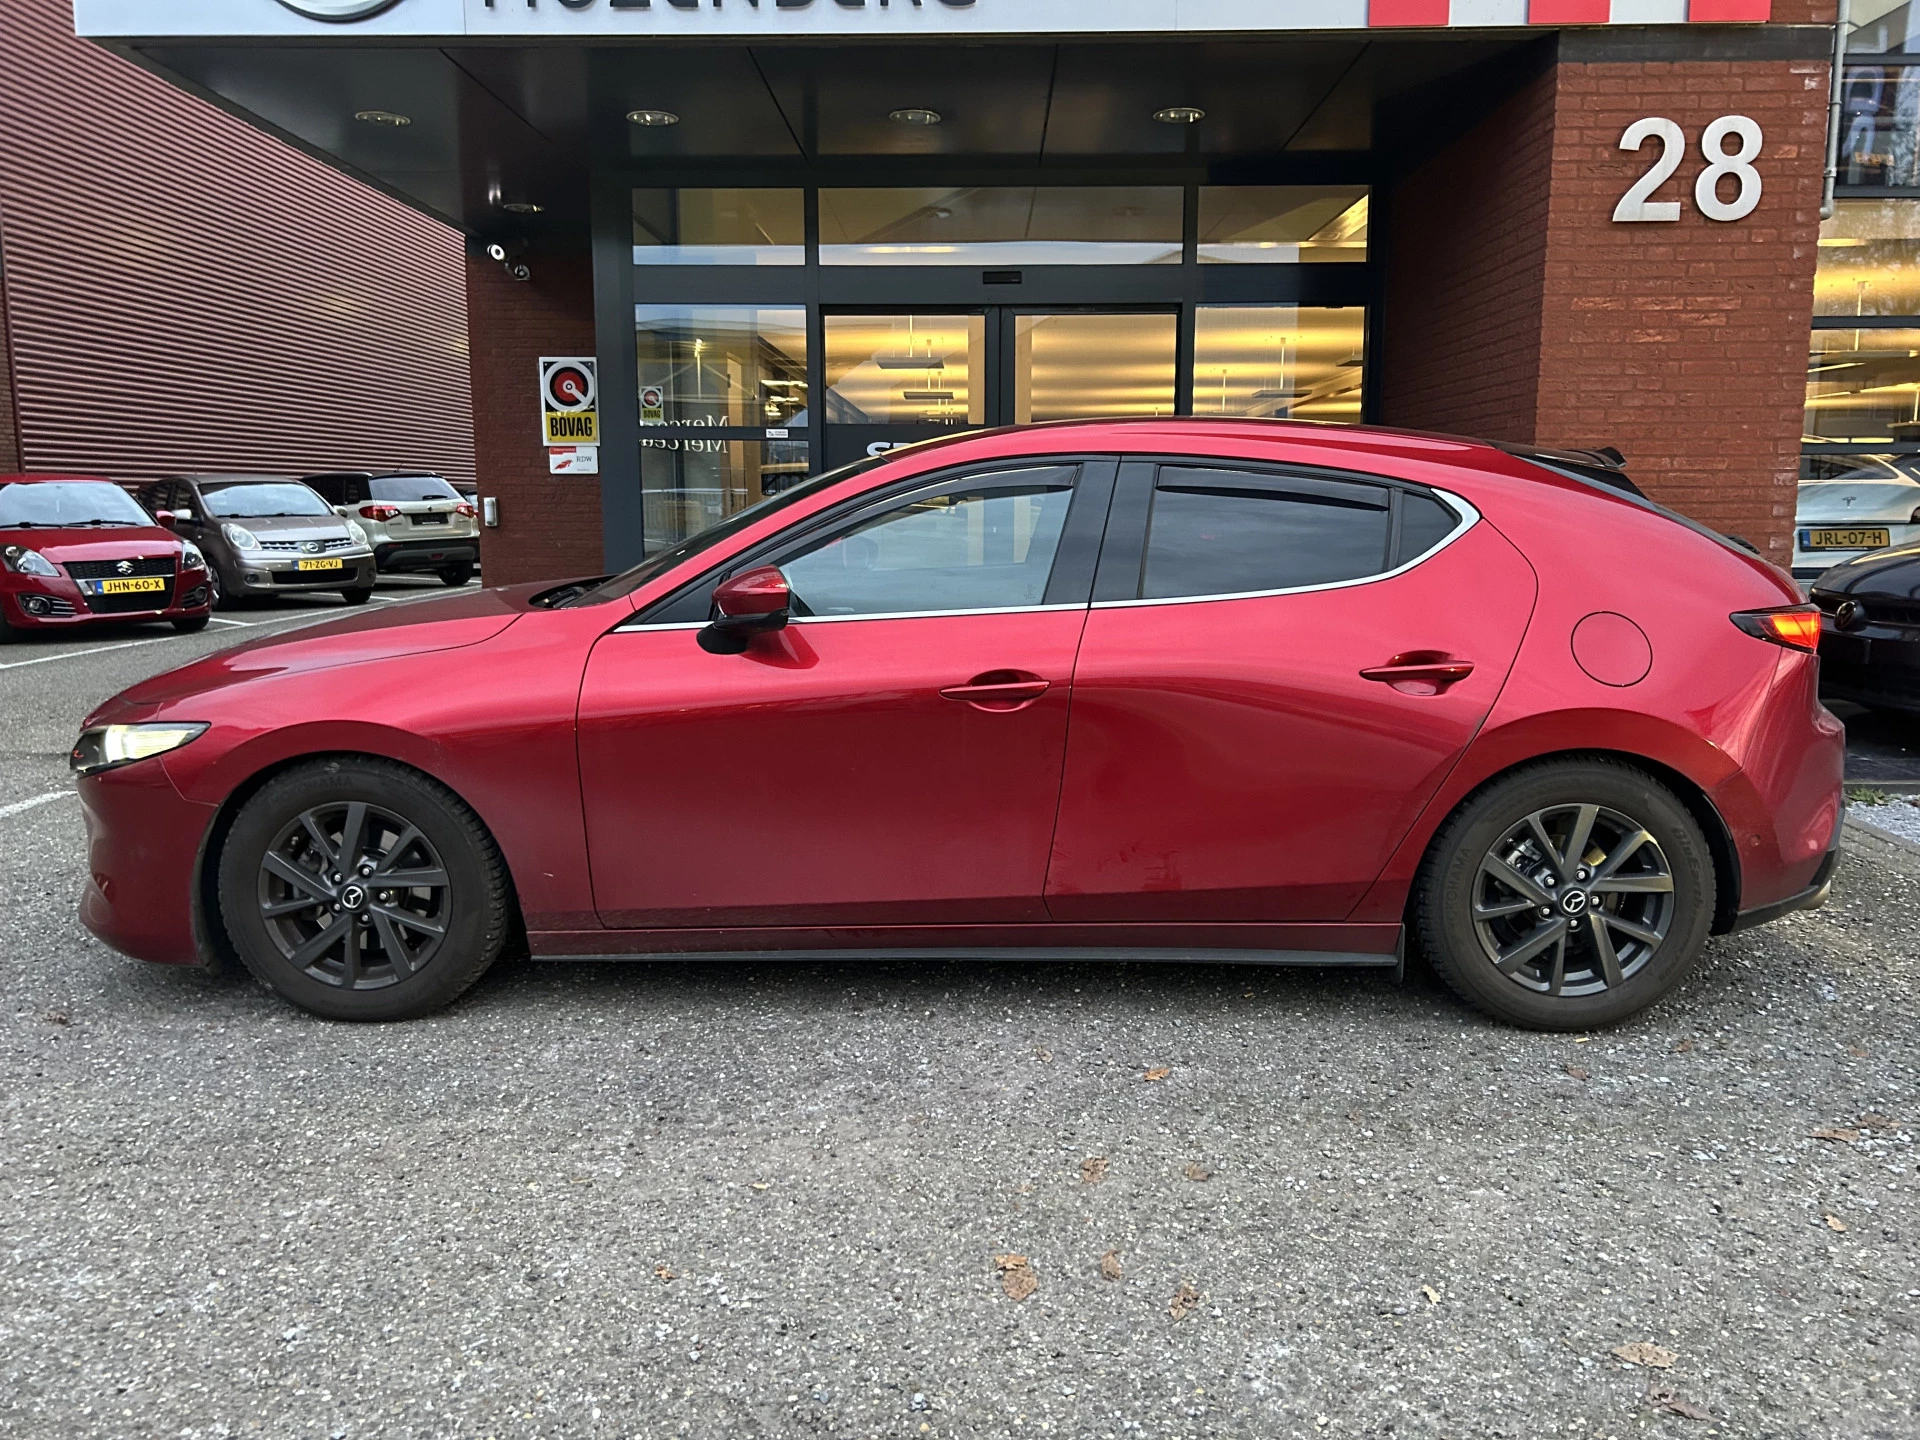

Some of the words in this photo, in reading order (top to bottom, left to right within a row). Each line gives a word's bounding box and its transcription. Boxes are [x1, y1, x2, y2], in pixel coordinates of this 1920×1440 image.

[1612, 115, 1763, 221] 28
[643, 409, 661, 419] BOVAG
[550, 417, 592, 437] BOVAG
[1816, 532, 1882, 545] JRL-07-H
[303, 560, 338, 569] 71-ZG-VJ
[107, 579, 161, 592] JHN-60-X
